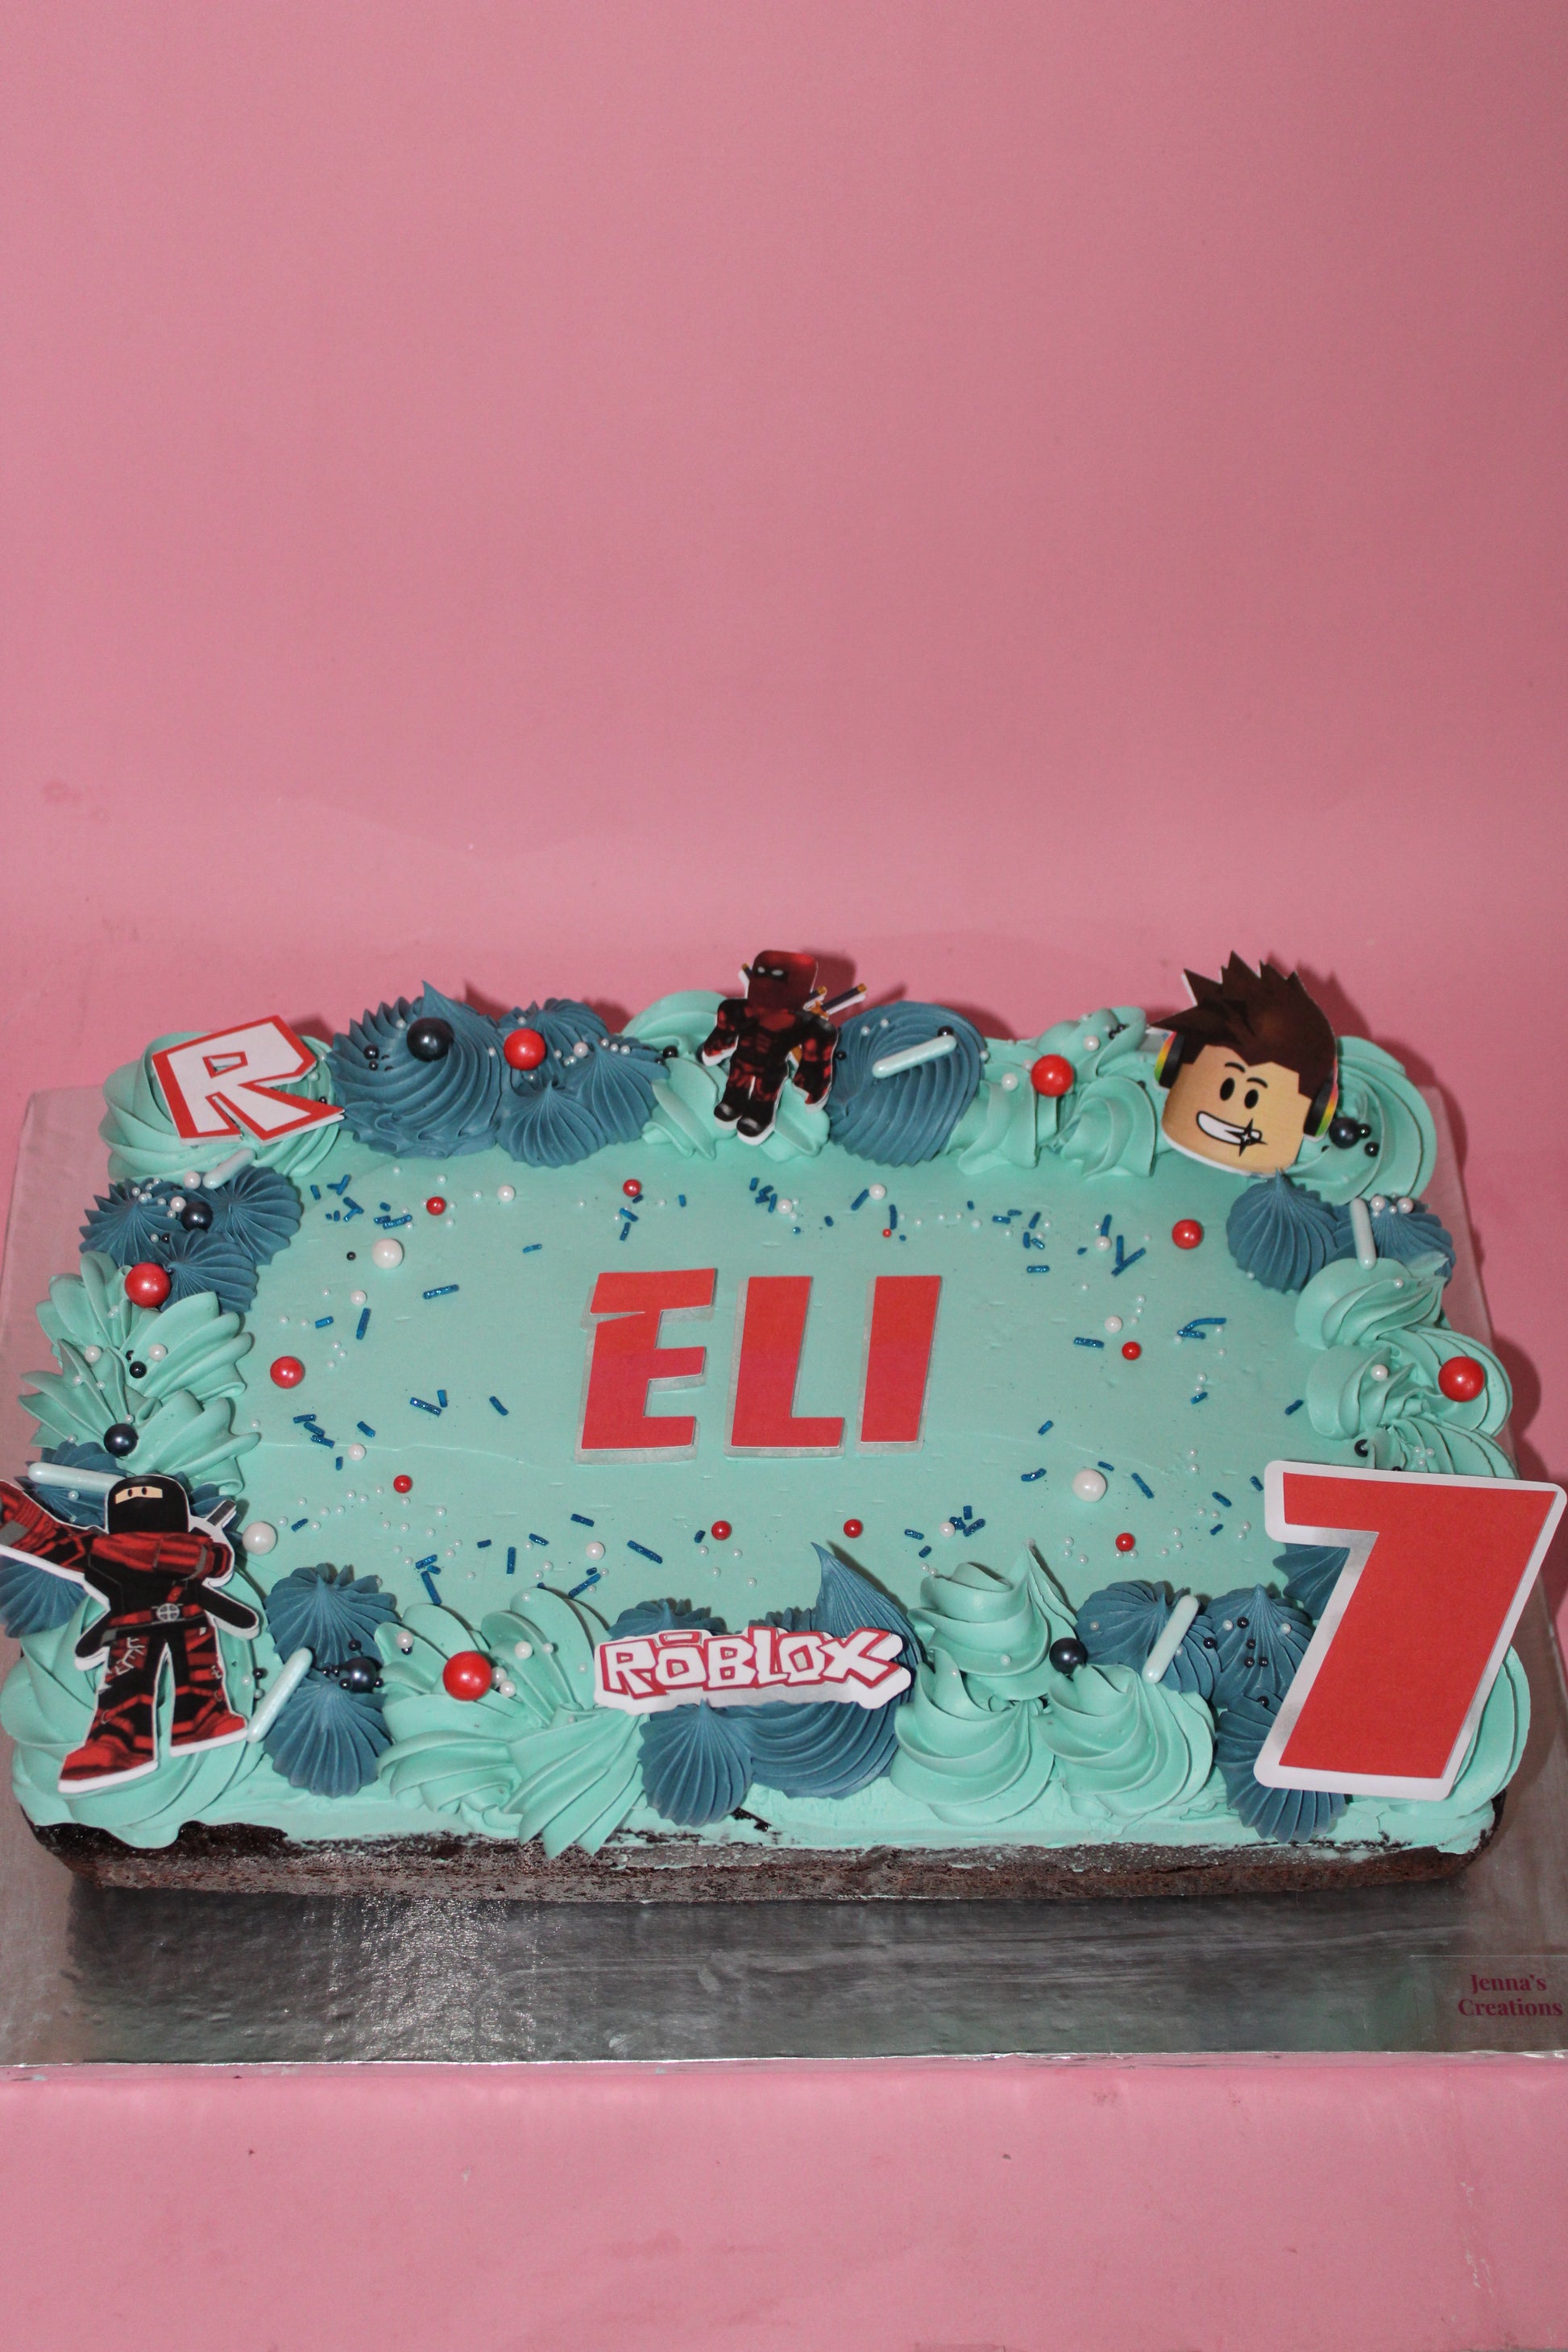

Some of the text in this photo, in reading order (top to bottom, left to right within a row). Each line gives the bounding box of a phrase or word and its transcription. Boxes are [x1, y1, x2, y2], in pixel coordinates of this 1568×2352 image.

[151, 1014, 345, 1141] R
[581, 1268, 941, 1450] ELI
[1278, 1471, 1558, 1779] 7
